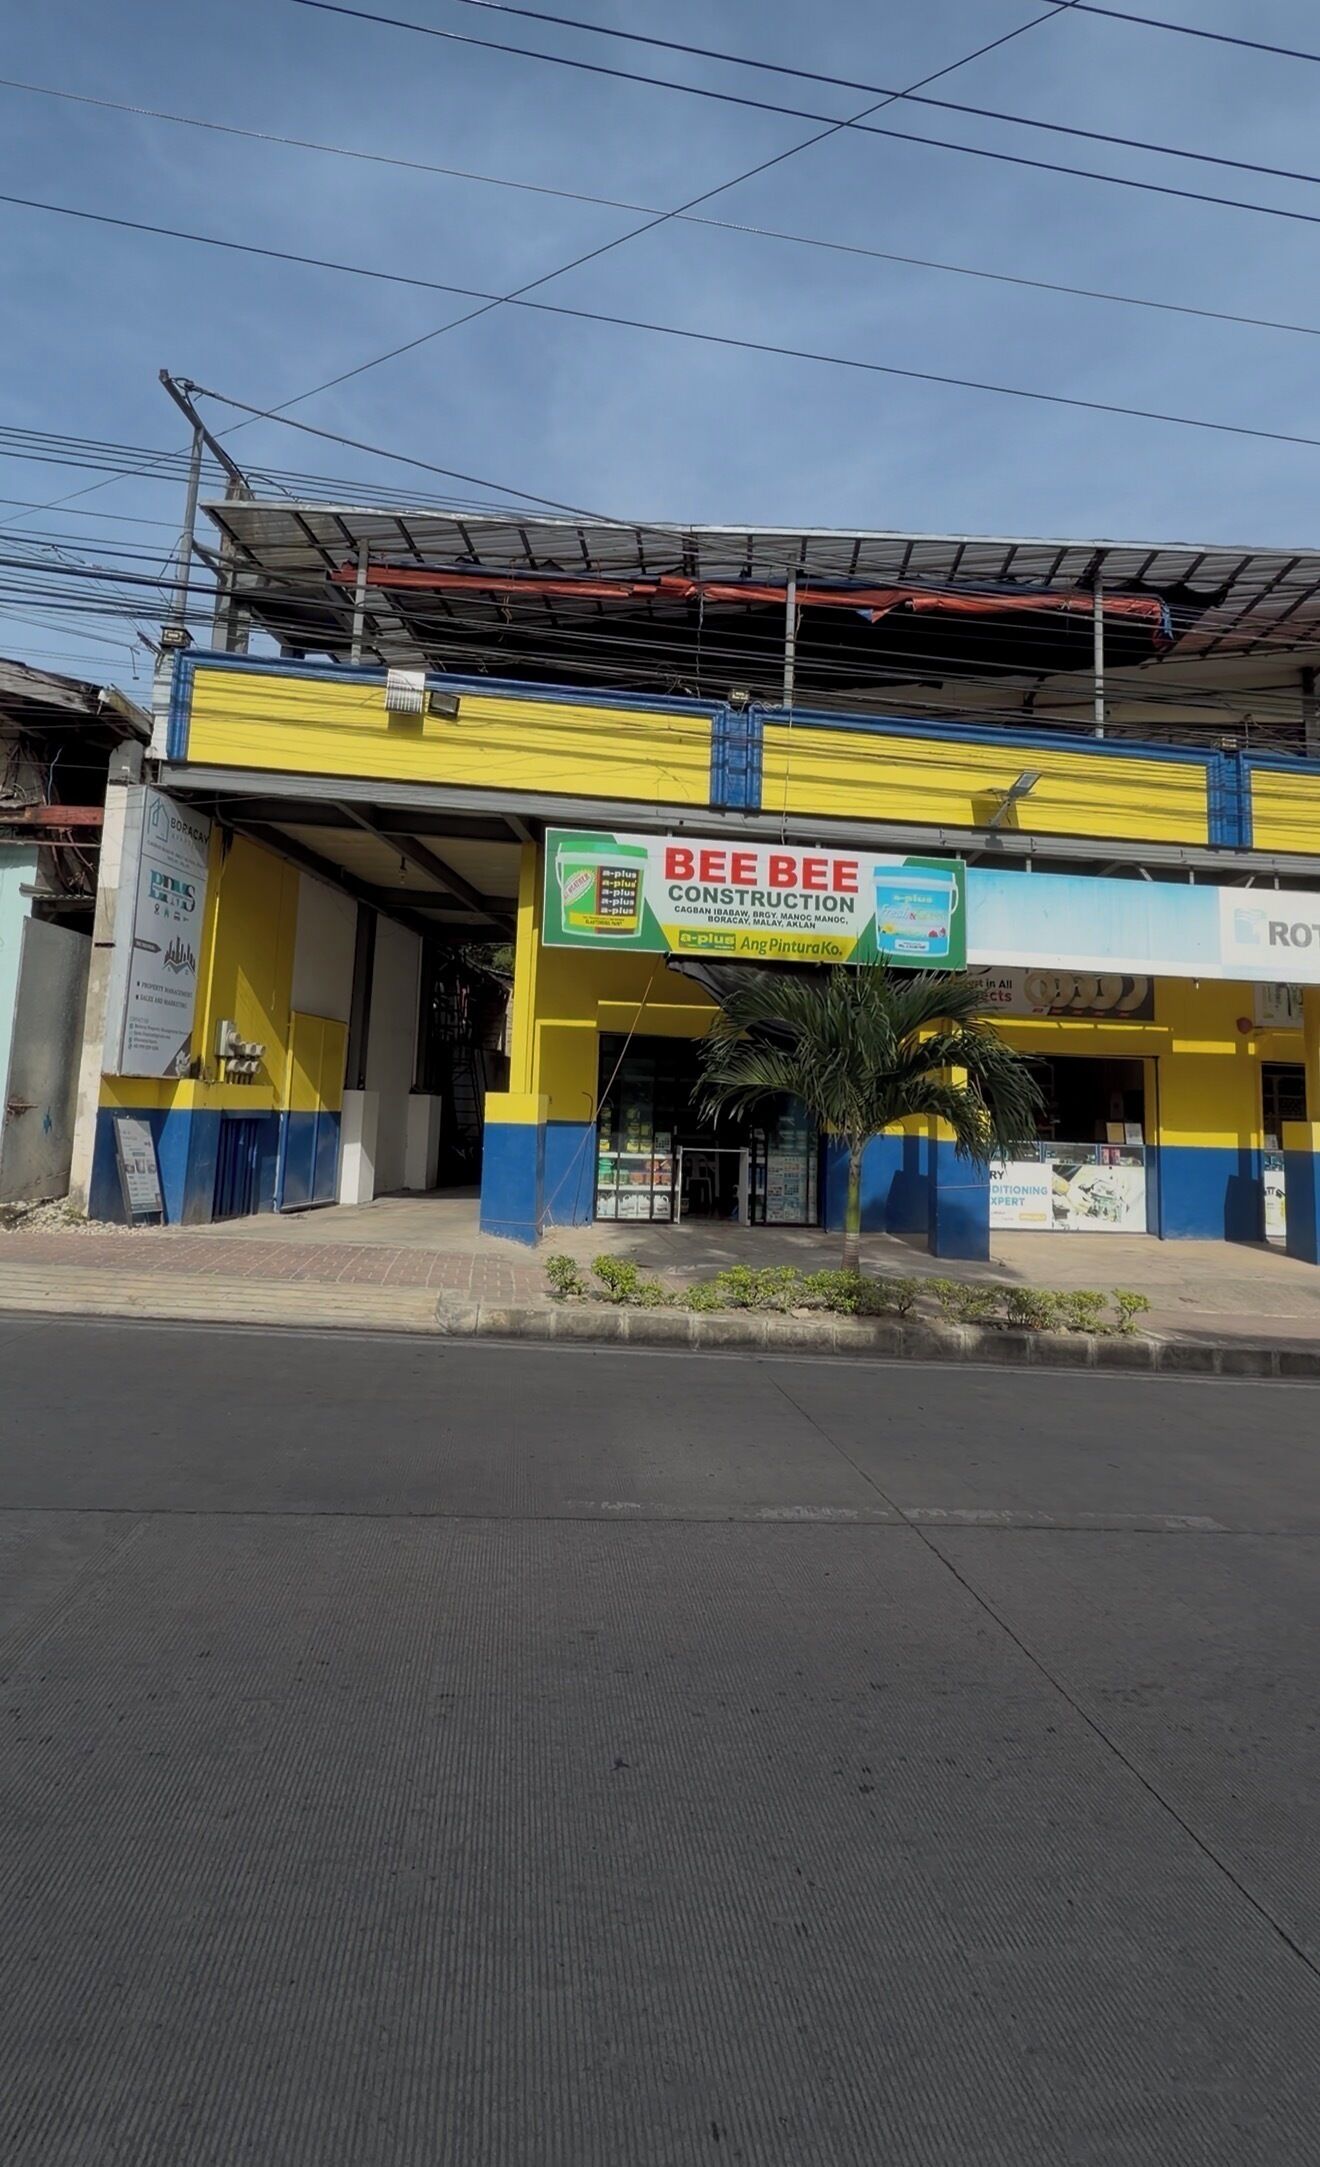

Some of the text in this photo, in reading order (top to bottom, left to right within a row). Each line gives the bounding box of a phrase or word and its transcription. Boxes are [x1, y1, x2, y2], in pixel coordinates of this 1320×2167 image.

[602, 870, 637, 879] a-plus
[665, 847, 859, 894] BEE BEE
[602, 879, 637, 888] a-plus
[601, 888, 635, 897] a-plus
[601, 898, 635, 906] a-plus
[668, 884, 855, 913] CONSTRUCTION
[600, 907, 634, 915] a-plus
[674, 905, 712, 915] CAGBAN
[714, 908, 750, 918] IBABAW,
[780, 913, 812, 922] MANOC
[814, 915, 849, 925] MANOC,
[707, 915, 816, 929] BORACAY, MALAY, AKLAN
[680, 932, 736, 945] a-plus
[740, 936, 768, 955] Ang
[999, 979, 1012, 989] All
[990, 1170, 1004, 1180] RY
[992, 1184, 1048, 1196] DITIONING
[991, 1196, 1025, 1207] XPERT
